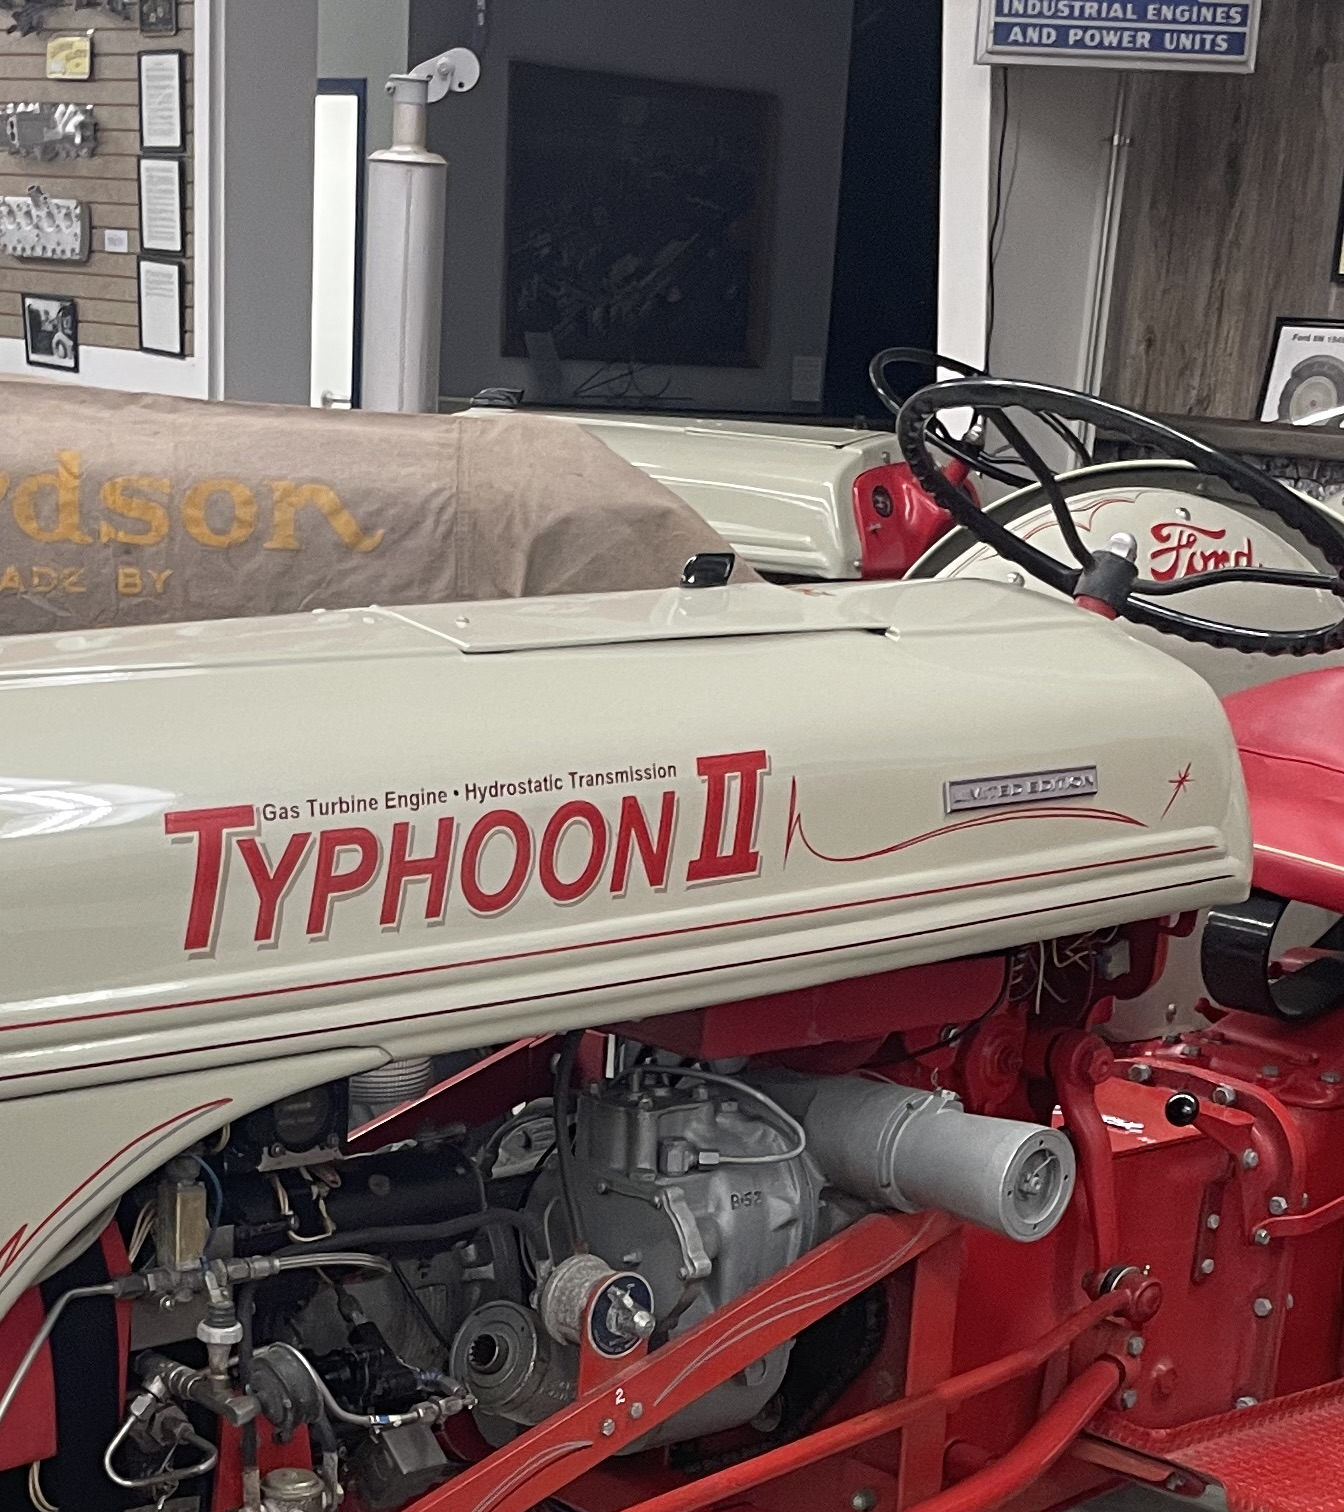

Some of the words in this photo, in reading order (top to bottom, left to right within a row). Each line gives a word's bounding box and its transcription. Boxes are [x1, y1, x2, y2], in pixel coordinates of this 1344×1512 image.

[1002, 0, 1137, 20] INDUSTRIAL
[1147, 4, 1242, 24] ENGINES
[1007, 25, 1056, 45] AND
[1068, 29, 1151, 49] POWER
[1164, 32, 1229, 51] UNITS
[117, 567, 175, 595] BY
[262, 803, 300, 822] Gas
[306, 795, 379, 817] Turbine
[384, 788, 448, 812] Engine
[464, 774, 564, 804] Hydrostatic
[568, 763, 677, 789] Transmission
[164, 791, 678, 952] TYPHOON
[615, 1388, 626, 1405] 2
